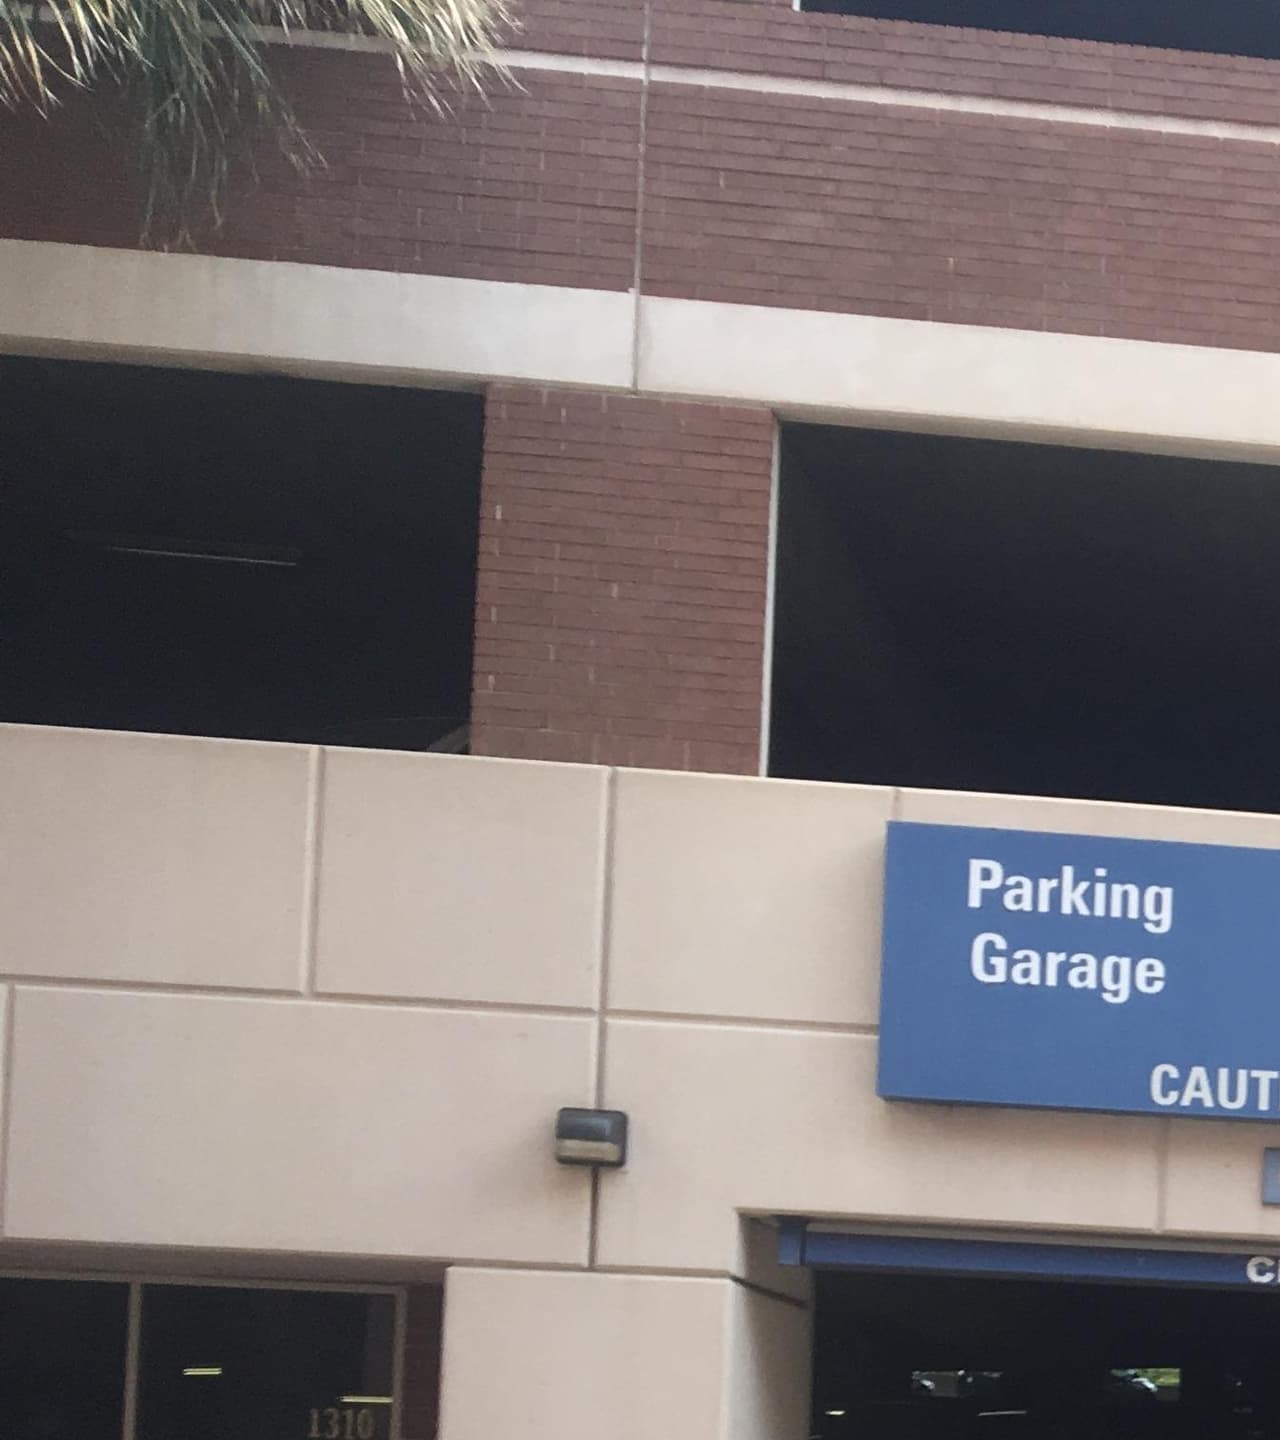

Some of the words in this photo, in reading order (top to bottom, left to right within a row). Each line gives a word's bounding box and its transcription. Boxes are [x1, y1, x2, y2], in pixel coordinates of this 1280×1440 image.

[967, 858, 1175, 934] Parking
[971, 933, 1166, 1004] Garage
[307, 1407, 375, 1440] 1310
